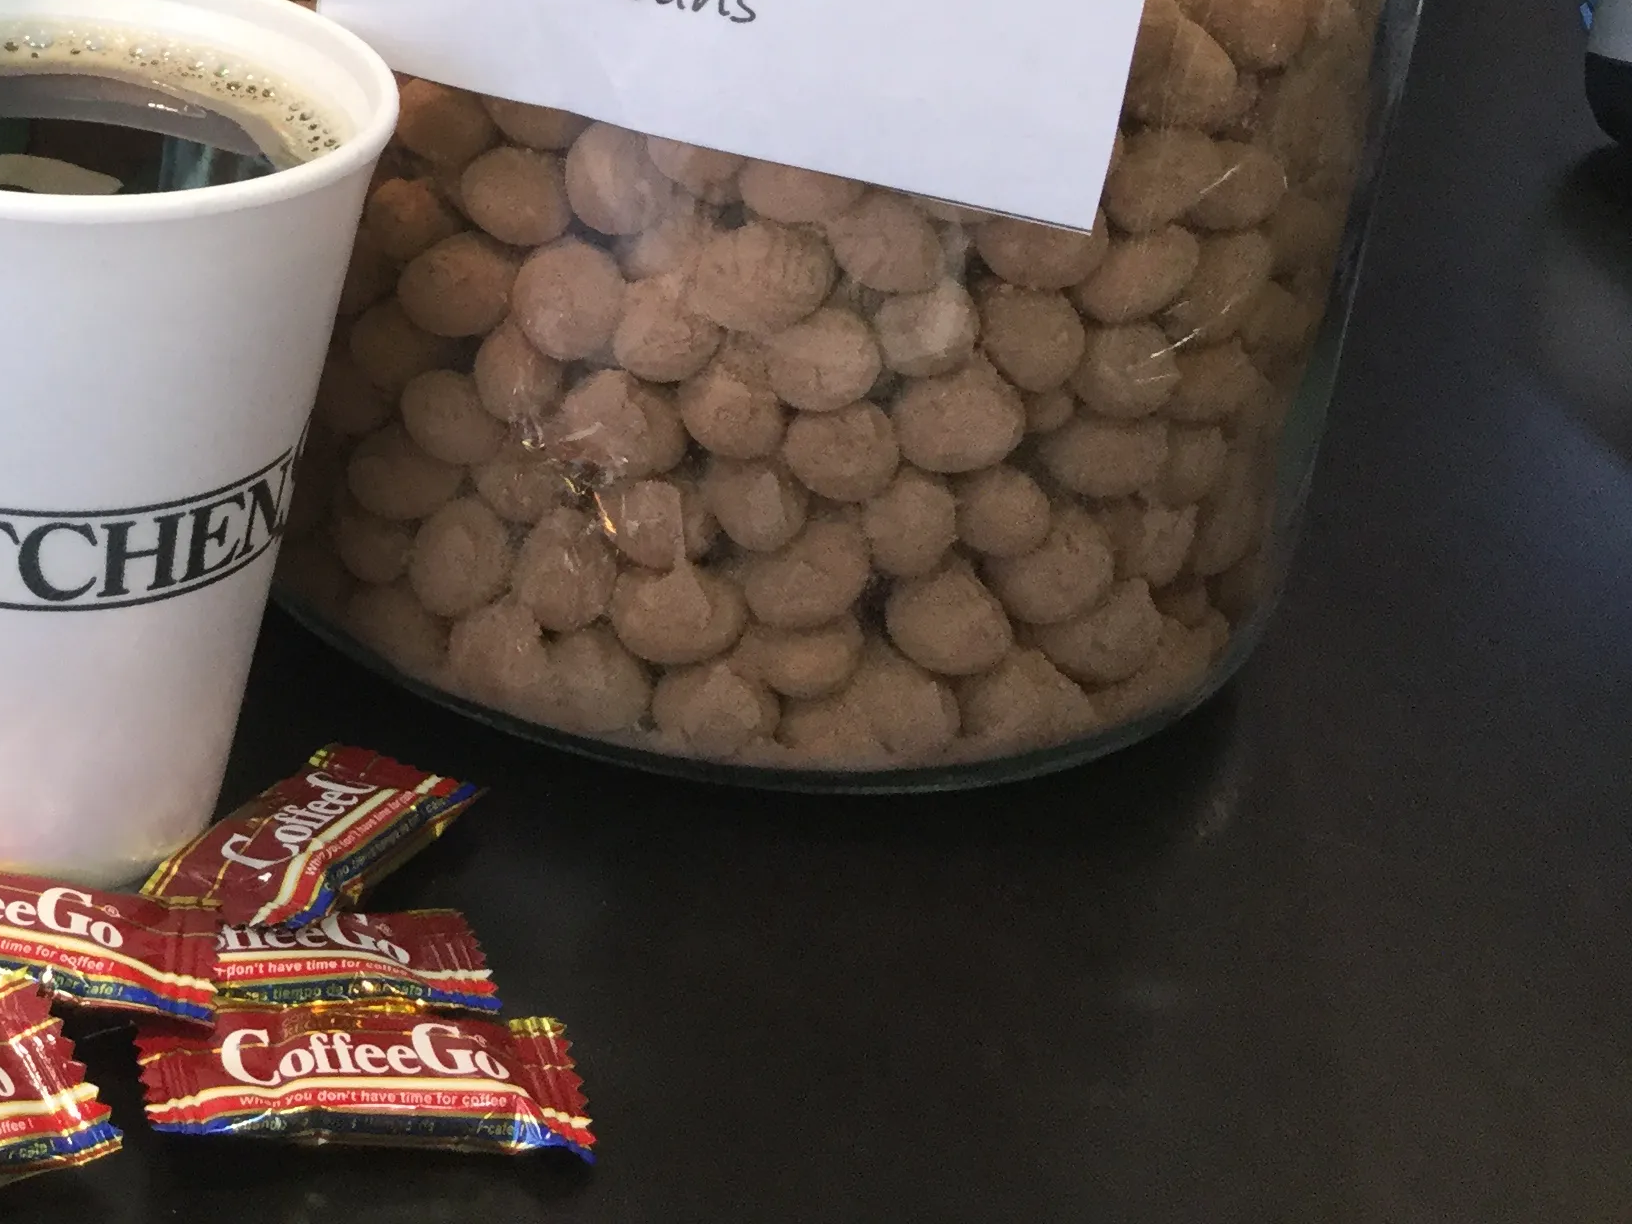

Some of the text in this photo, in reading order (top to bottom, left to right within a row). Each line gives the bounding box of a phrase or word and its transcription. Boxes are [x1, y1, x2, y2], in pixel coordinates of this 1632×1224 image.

[0, 938, 33, 955] time
[34, 944, 58, 959] for
[225, 961, 265, 978] don't
[267, 960, 302, 975] have
[306, 958, 339, 971] time
[341, 958, 362, 970] for
[220, 1022, 510, 1086] CoffeeGo
[284, 1090, 313, 1107] you
[316, 1089, 356, 1103] don't
[360, 1089, 396, 1103] have
[399, 1091, 433, 1105] time
[436, 1093, 458, 1106] for
[461, 1094, 508, 1108] coffee
